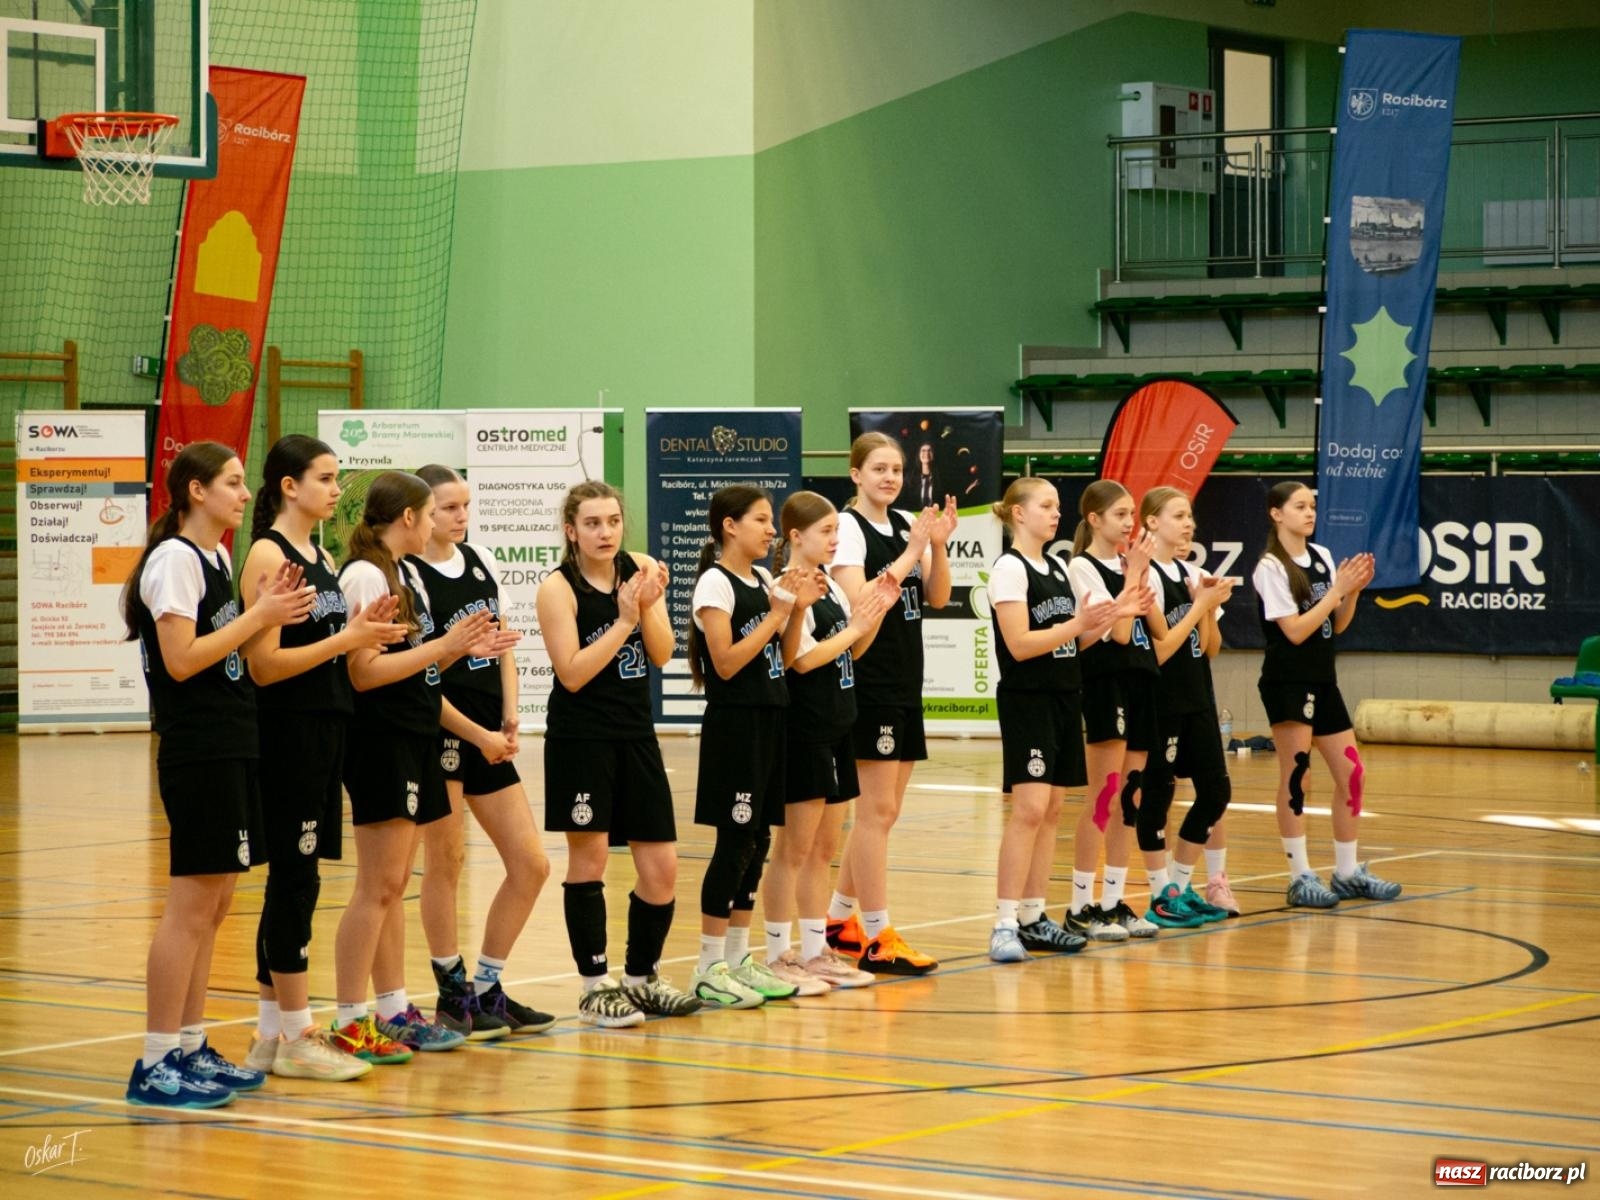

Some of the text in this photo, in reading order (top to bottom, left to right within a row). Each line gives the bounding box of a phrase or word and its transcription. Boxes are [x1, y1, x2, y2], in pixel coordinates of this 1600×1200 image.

[1382, 92, 1447, 109] Racibórz
[234, 123, 291, 143] Racibórz
[371, 421, 420, 429] Arboretum
[28, 425, 79, 438] SOWA
[371, 431, 400, 440] Bramy
[403, 431, 454, 440] Morawskiej
[477, 425, 567, 442] ostromed
[477, 443, 567, 452] CENTRUM MEDYCZNE
[660, 437, 788, 452] DENTAL STUDIO
[1328, 441, 1377, 463] Dodaj
[349, 455, 392, 466] Przyroda
[687, 456, 723, 464] Katarzyna
[30, 467, 111, 478] Eksperymentuj!
[1326, 461, 1387, 479] od siebie
[30, 484, 87, 495] Sprawdzaj!
[478, 482, 566, 490] DIAGNOSTYKA USG
[661, 480, 697, 490] Racibórz,
[698, 480, 709, 489] ul.
[760, 480, 787, 489] 13b/2a
[692, 492, 707, 500] Tel.
[30, 500, 82, 512] Obserwuj!
[478, 499, 543, 507] PRZYCHODNIA
[478, 507, 560, 516] WIELOSPECJALIST
[30, 516, 69, 528] Działaj!
[480, 524, 489, 532] 19
[30, 532, 98, 544] Doświadczaj!
[493, 546, 561, 567] AMIĘT
[949, 561, 985, 569] PORTOWA
[901, 586, 921, 621] 11
[1441, 587, 1546, 610] RACIBÓRZ
[615, 640, 647, 679] 21
[974, 626, 989, 694] OFERTA
[575, 793, 591, 803] AF
[735, 792, 752, 803] MZ
